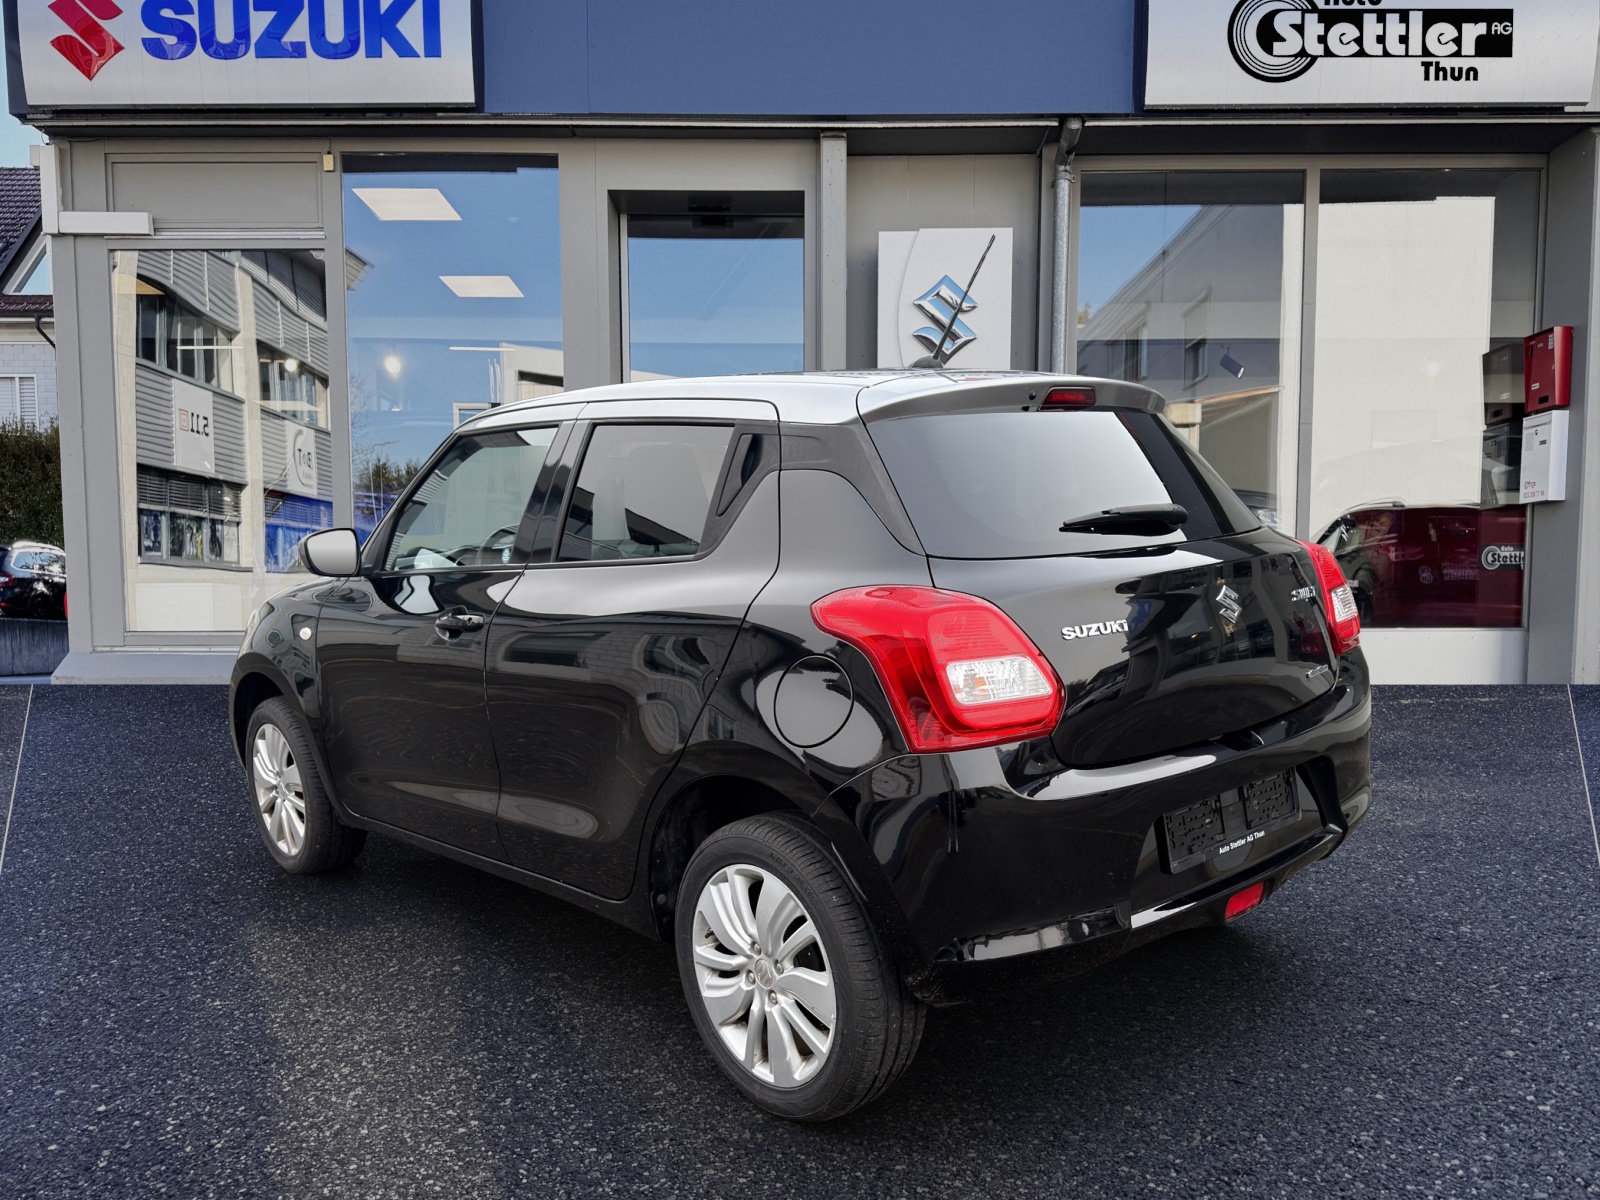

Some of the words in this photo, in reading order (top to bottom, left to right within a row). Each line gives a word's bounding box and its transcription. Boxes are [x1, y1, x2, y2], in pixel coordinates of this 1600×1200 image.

[141, 0, 441, 60] SUZUKI
[1273, 11, 1487, 56] Stettler
[1491, 22, 1512, 35] AG
[1421, 61, 1478, 81] Thun
[1061, 619, 1128, 640] SUZUKI
[1219, 846, 1229, 854] Auto
[1230, 839, 1246, 849] Stettler
[1246, 834, 1254, 842] AG
[1254, 831, 1265, 839] Thun
